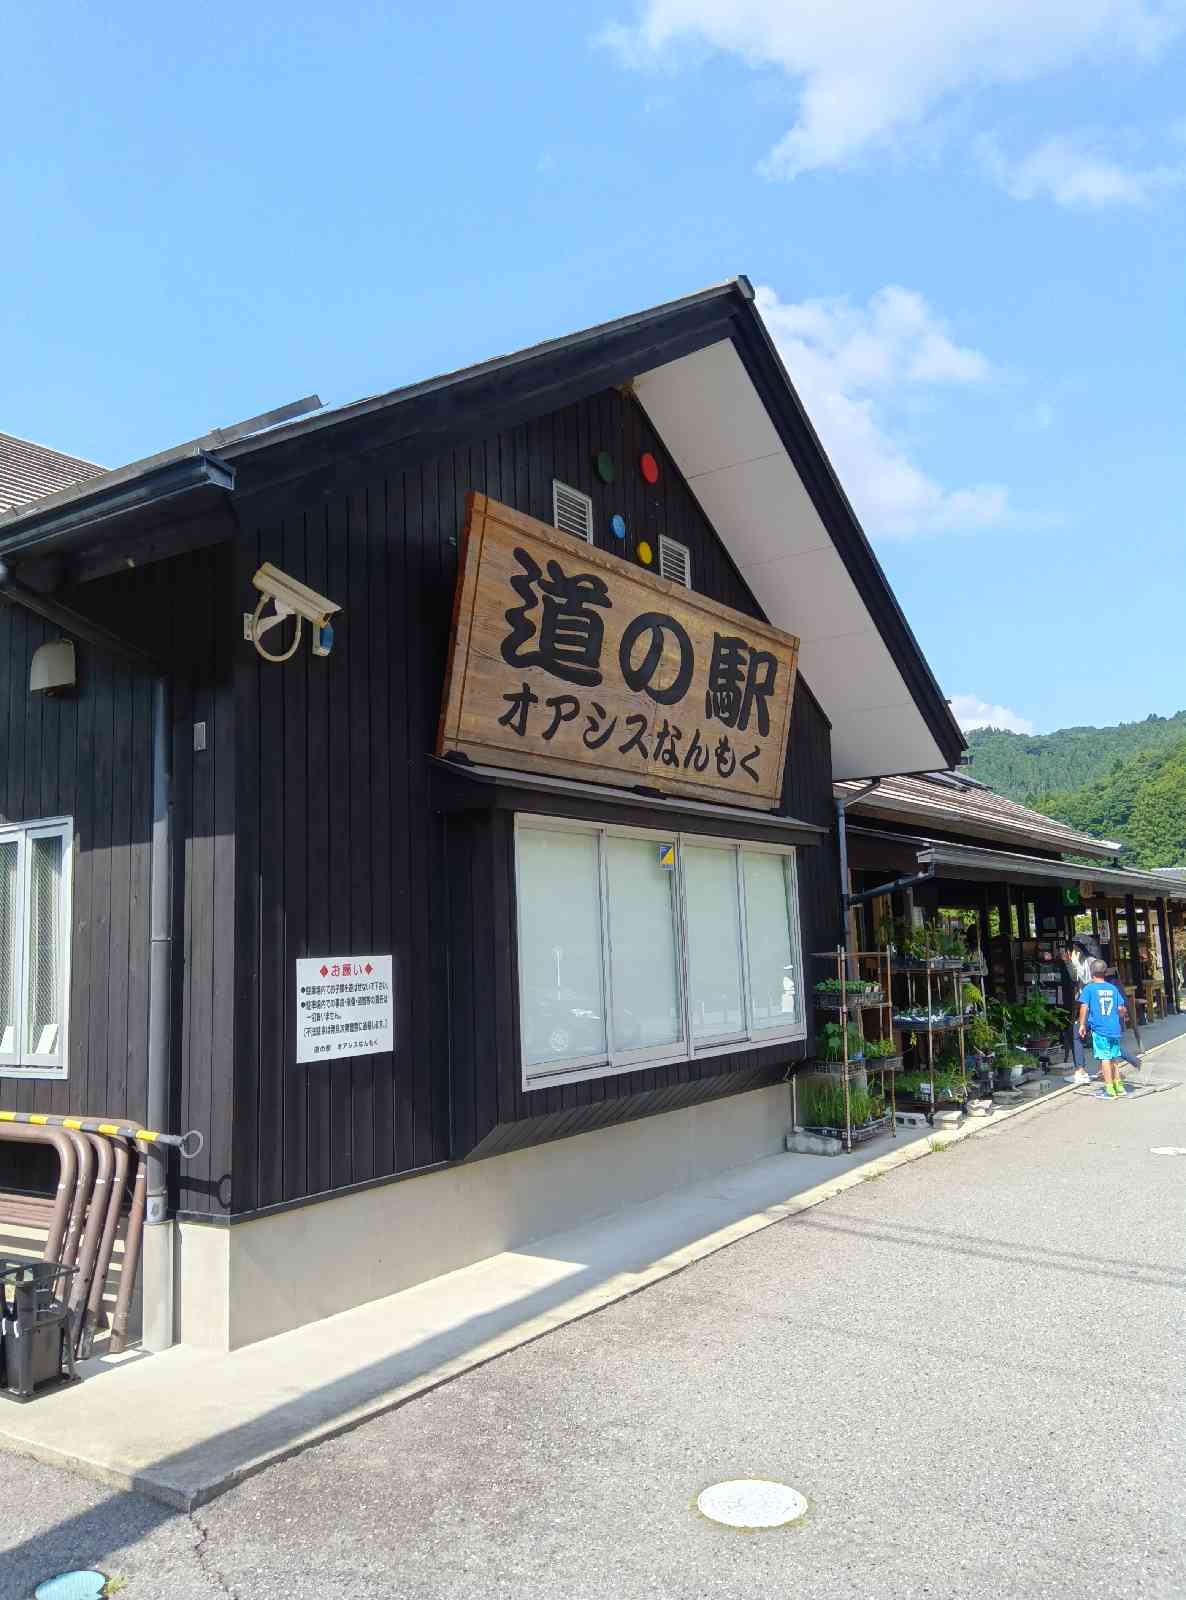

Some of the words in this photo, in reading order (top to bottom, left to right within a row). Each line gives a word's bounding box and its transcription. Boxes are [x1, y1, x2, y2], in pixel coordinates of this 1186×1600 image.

[501, 547, 778, 737] 道の駅
[498, 683, 760, 783] オアシスなんもく
[331, 963, 363, 977] お願い
[1099, 997, 1113, 1016] 17
